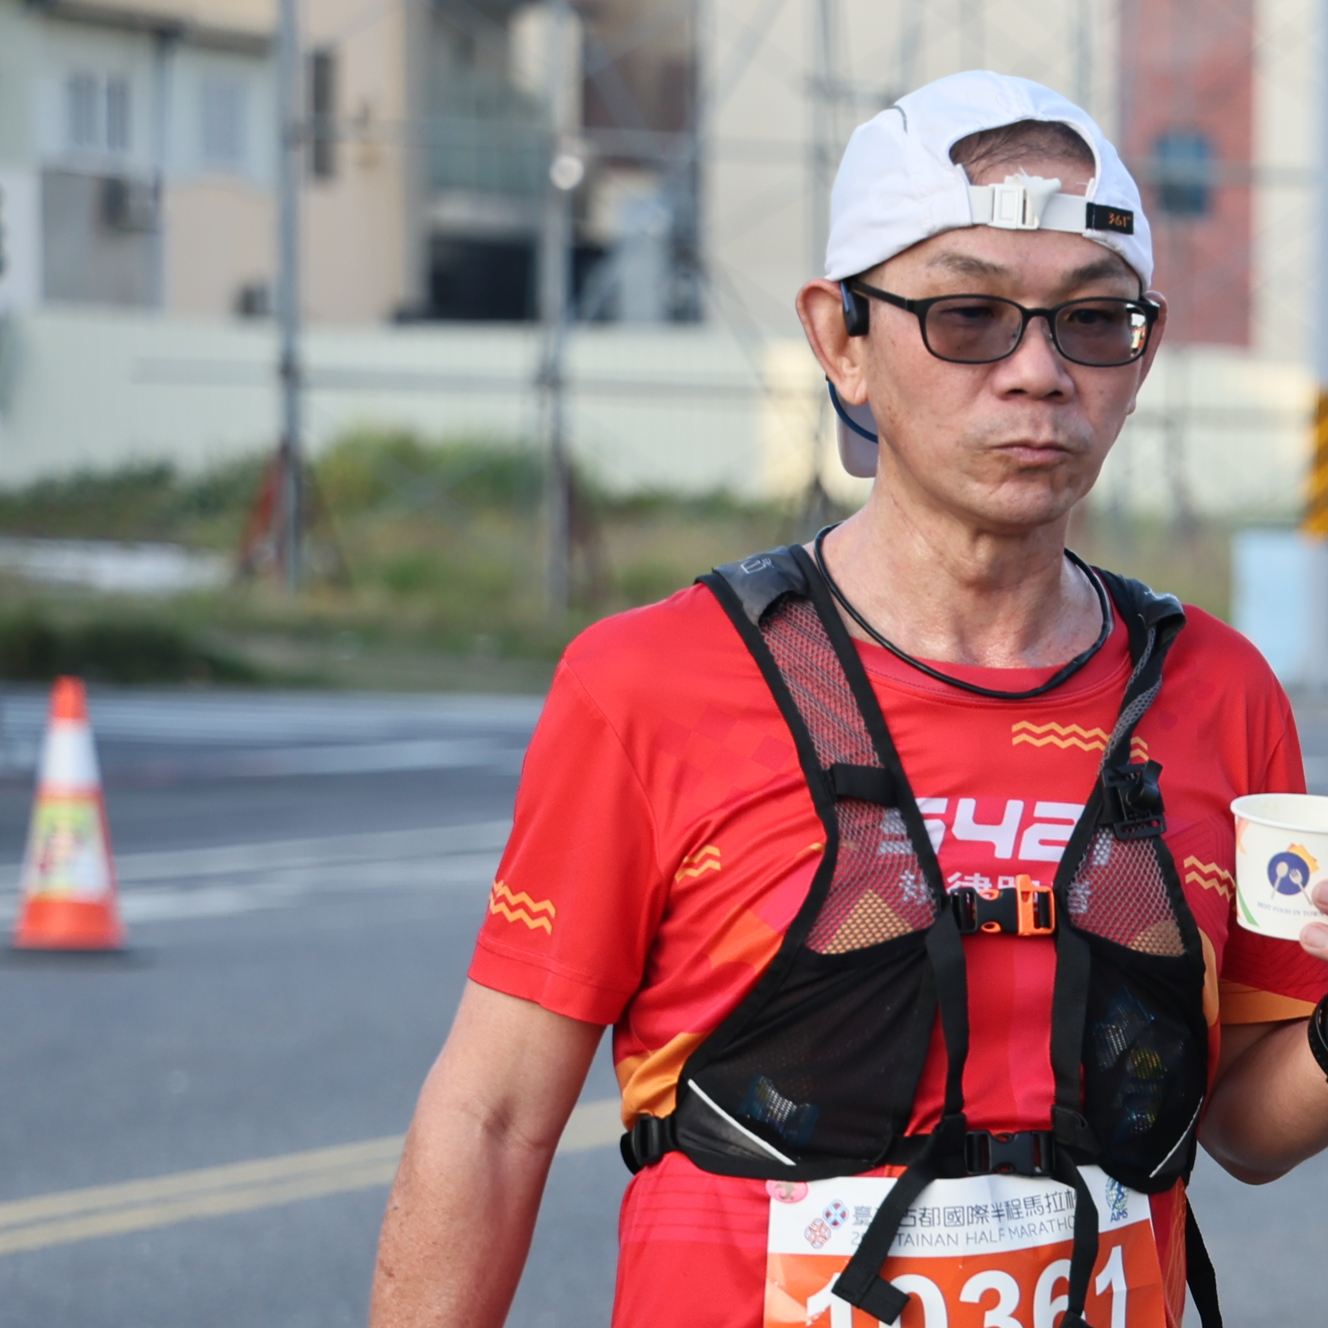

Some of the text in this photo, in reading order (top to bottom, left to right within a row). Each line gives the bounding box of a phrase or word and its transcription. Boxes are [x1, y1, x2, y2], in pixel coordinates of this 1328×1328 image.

[1257, 901, 1272, 911] BEST
[1272, 905, 1292, 914] FOOD
[853, 1188, 1077, 1228] 臺古都國際半程馬拉
[898, 1215, 1076, 1248] TAINAN HALF MARATHO
